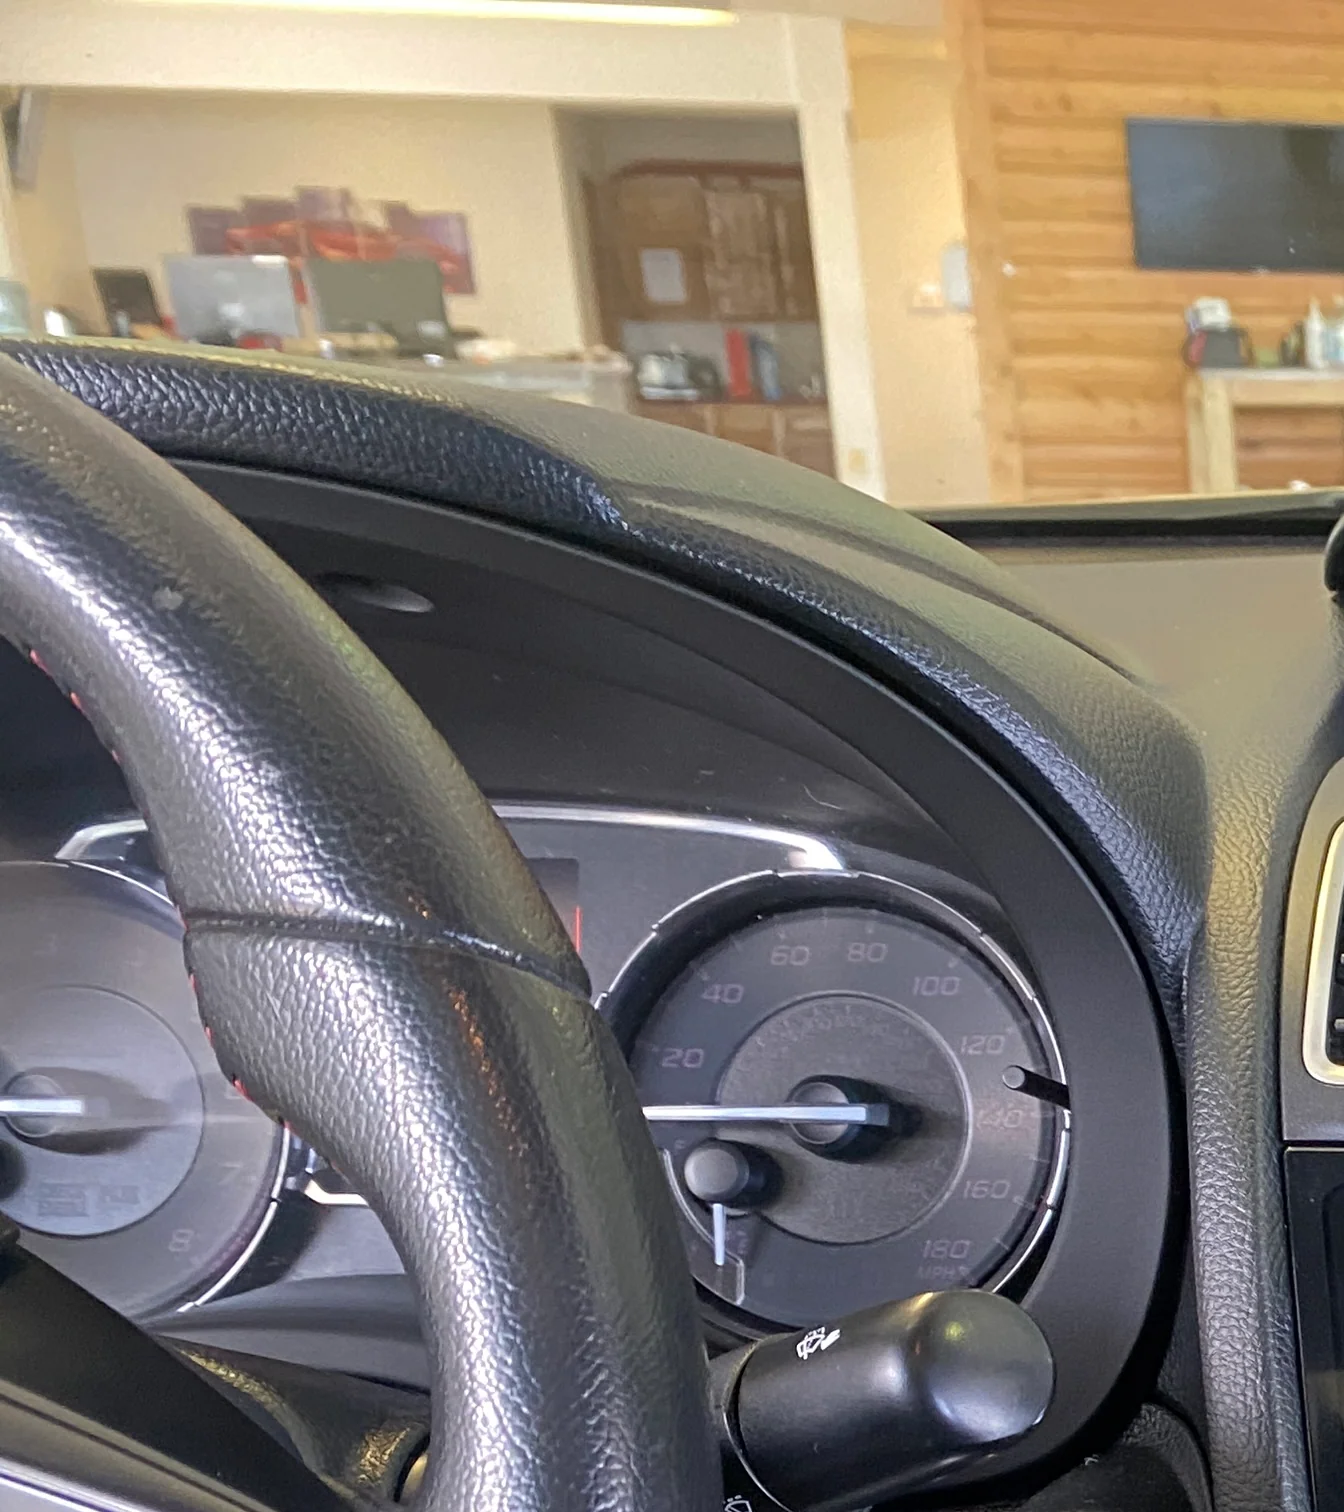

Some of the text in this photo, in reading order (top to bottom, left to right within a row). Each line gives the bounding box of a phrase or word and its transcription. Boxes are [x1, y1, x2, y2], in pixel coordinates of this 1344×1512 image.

[770, 945, 811, 966] 60
[848, 942, 888, 963] 80
[701, 983, 744, 1004] 40
[912, 976, 960, 996] 100
[959, 1034, 1006, 1056] 120
[661, 1048, 705, 1069] 20
[963, 1179, 1011, 1200] 160
[168, 1229, 194, 1252] 8
[922, 1240, 971, 1259] 180
